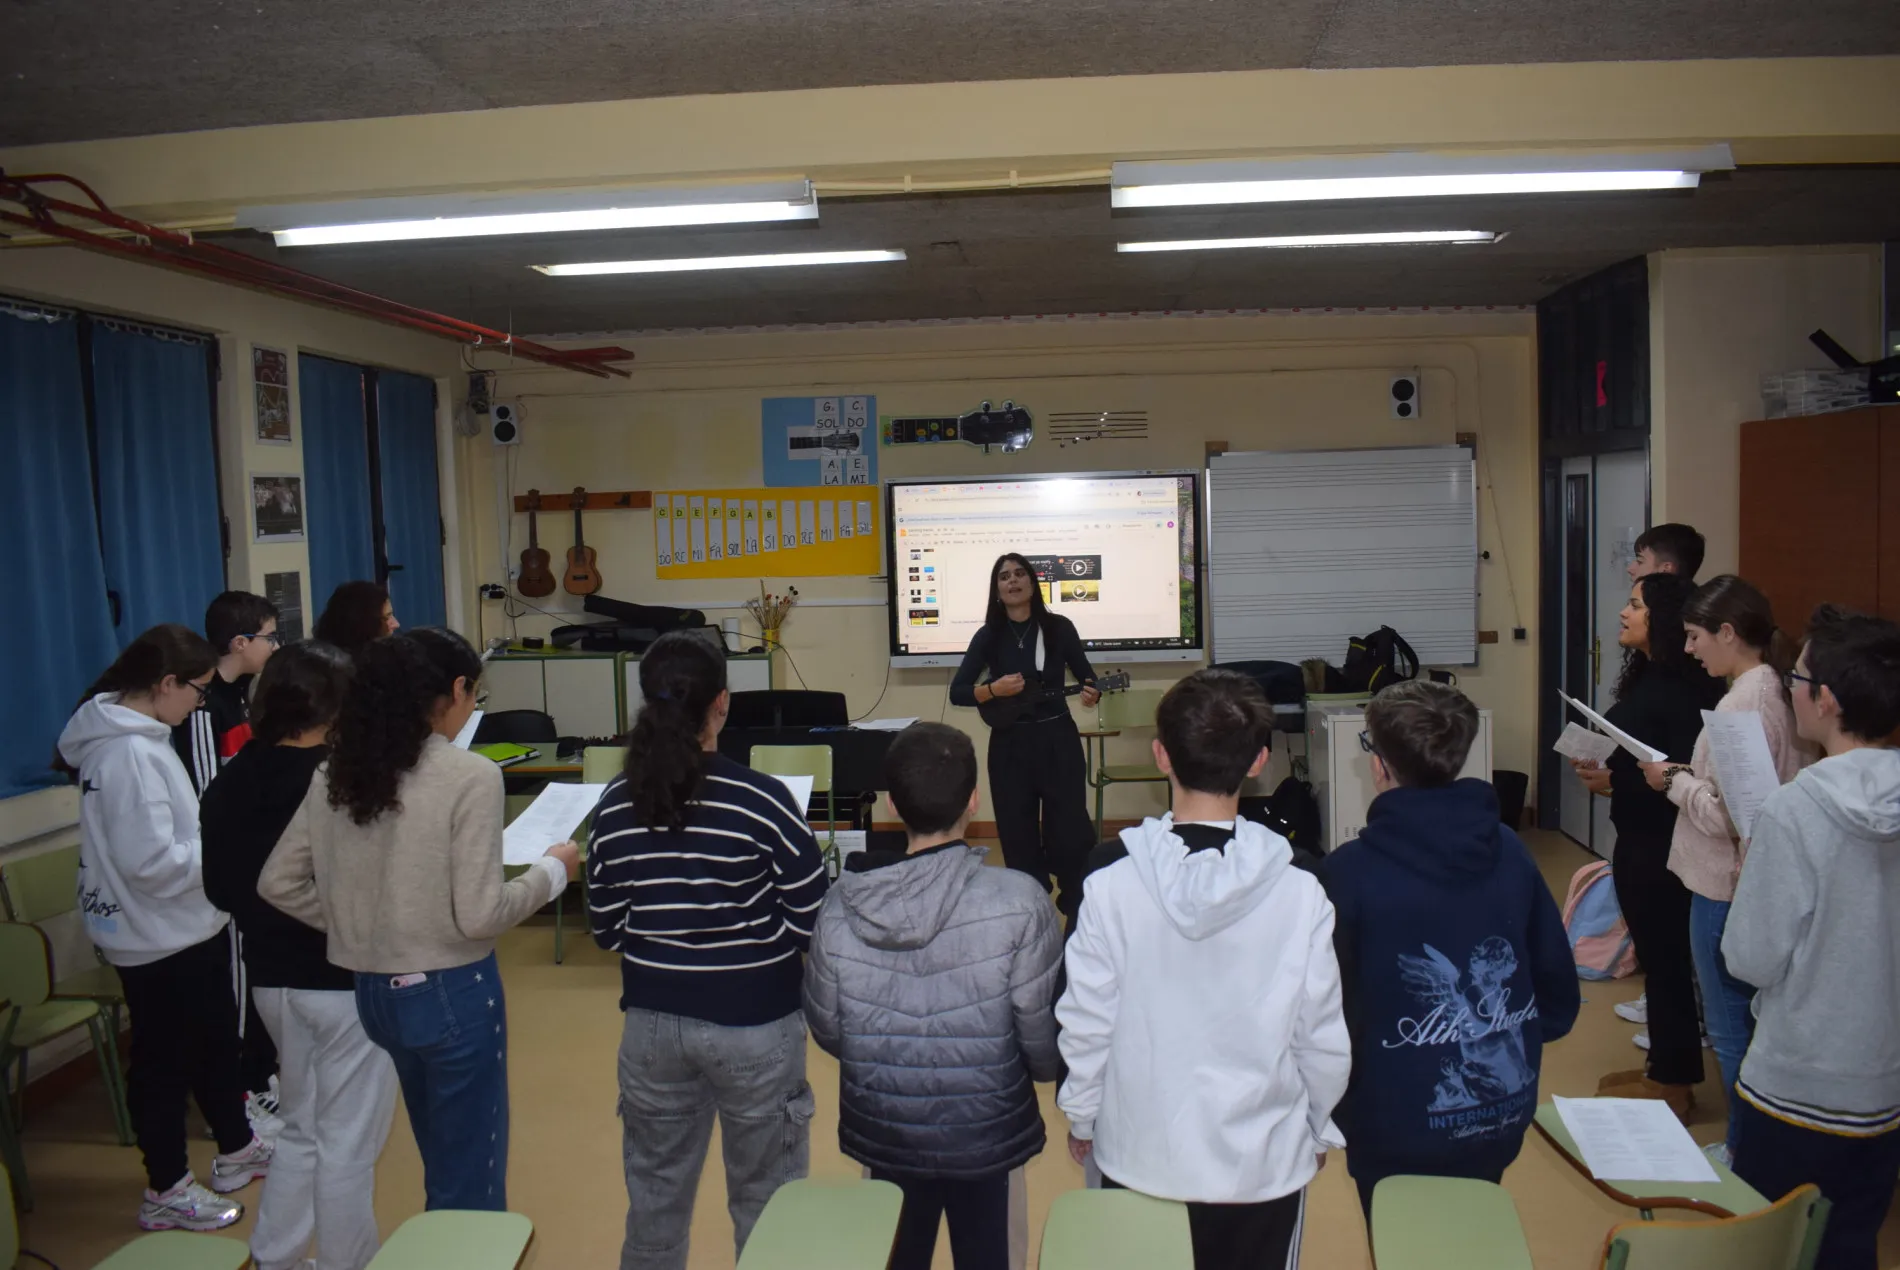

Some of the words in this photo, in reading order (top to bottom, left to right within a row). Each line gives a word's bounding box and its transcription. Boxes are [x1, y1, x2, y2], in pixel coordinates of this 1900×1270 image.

[816, 418, 839, 429] SOL
[847, 417, 865, 428] DO
[824, 475, 839, 485] LA
[850, 474, 867, 485] MI
[658, 554, 672, 566] DO
[674, 551, 686, 563] RE
[692, 549, 703, 561] MI
[709, 544, 722, 558] FA
[727, 543, 742, 556] SOL
[745, 539, 758, 553] LA
[764, 535, 775, 550] SI
[782, 534, 796, 547] DO
[800, 531, 814, 545] RE
[820, 528, 832, 541] MI
[840, 525, 851, 537] FA
[1428, 1091, 1529, 1130] INTERNATION
